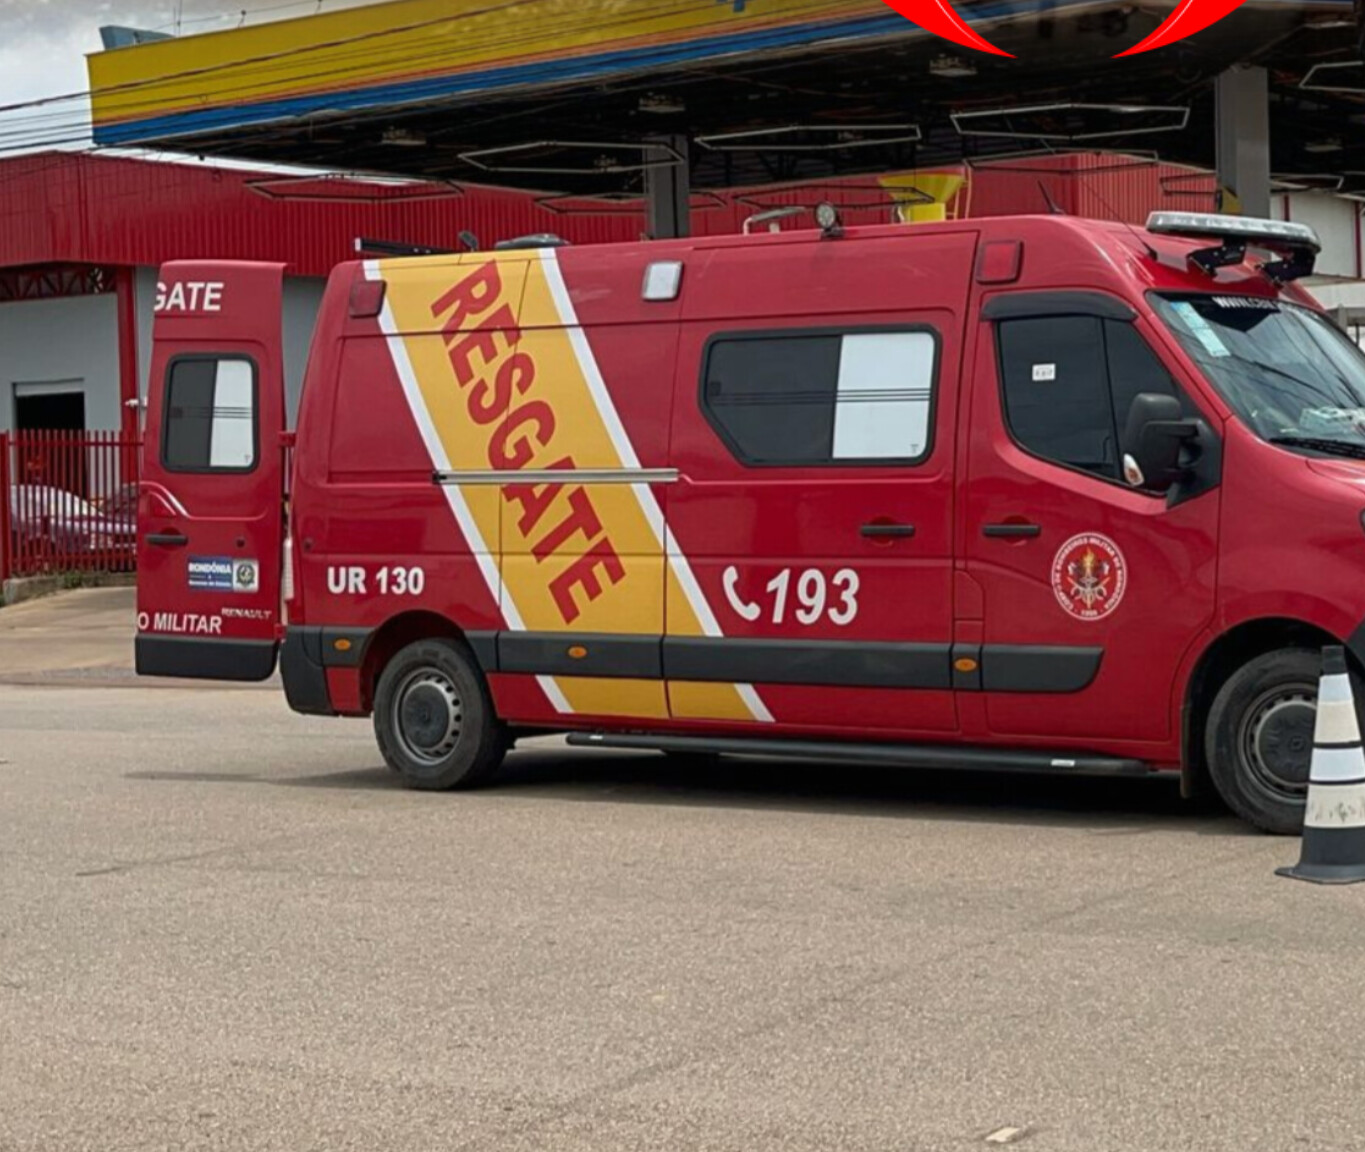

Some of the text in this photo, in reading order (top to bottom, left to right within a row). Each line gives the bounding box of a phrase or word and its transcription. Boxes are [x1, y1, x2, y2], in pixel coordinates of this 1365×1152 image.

[430, 259, 627, 626] RESGATE
[327, 566, 425, 595] UR 130
[766, 568, 860, 626] 193
[153, 611, 223, 635] MILITAR
[221, 606, 273, 620] RENAULT
